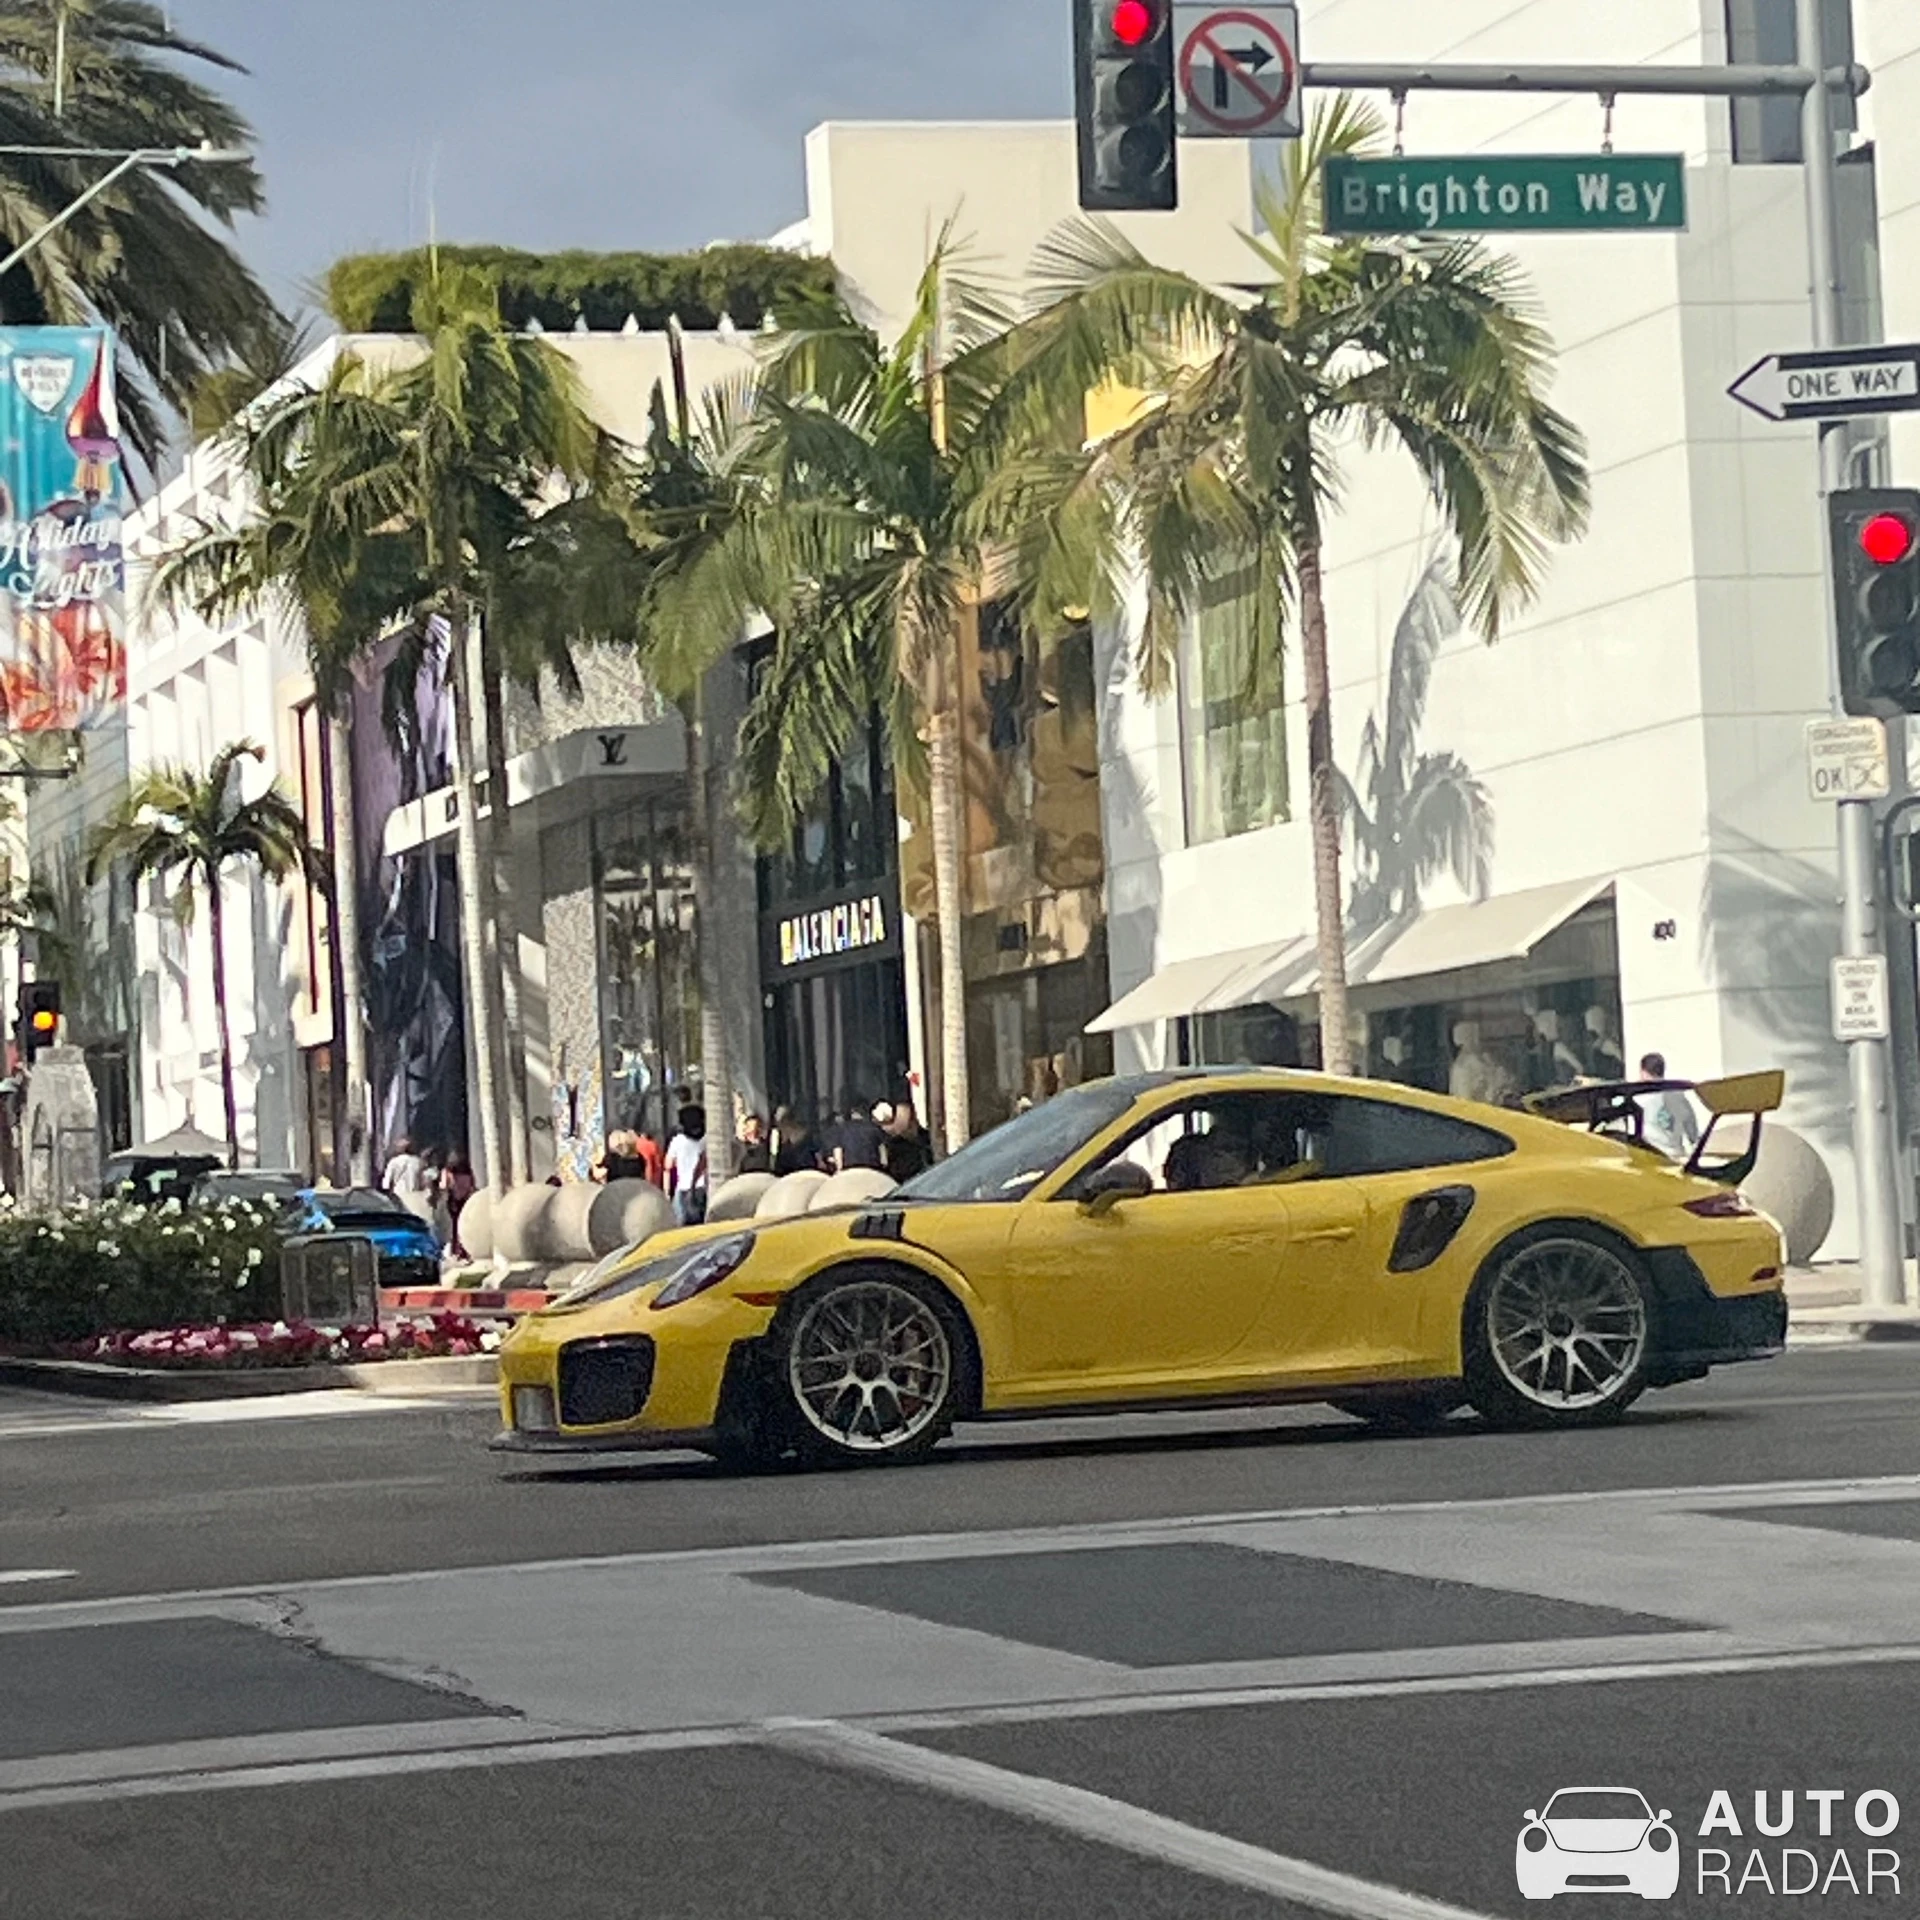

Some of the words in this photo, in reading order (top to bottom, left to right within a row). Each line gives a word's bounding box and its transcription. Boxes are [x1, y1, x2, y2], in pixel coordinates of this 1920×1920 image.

[1342, 174, 1550, 228] Brighton
[1577, 173, 1666, 222] Way
[1788, 372, 1841, 399] ONE
[1850, 366, 1904, 394] WAY
[1815, 767, 1844, 793] OK
[780, 895, 886, 966] BALENCIAGA
